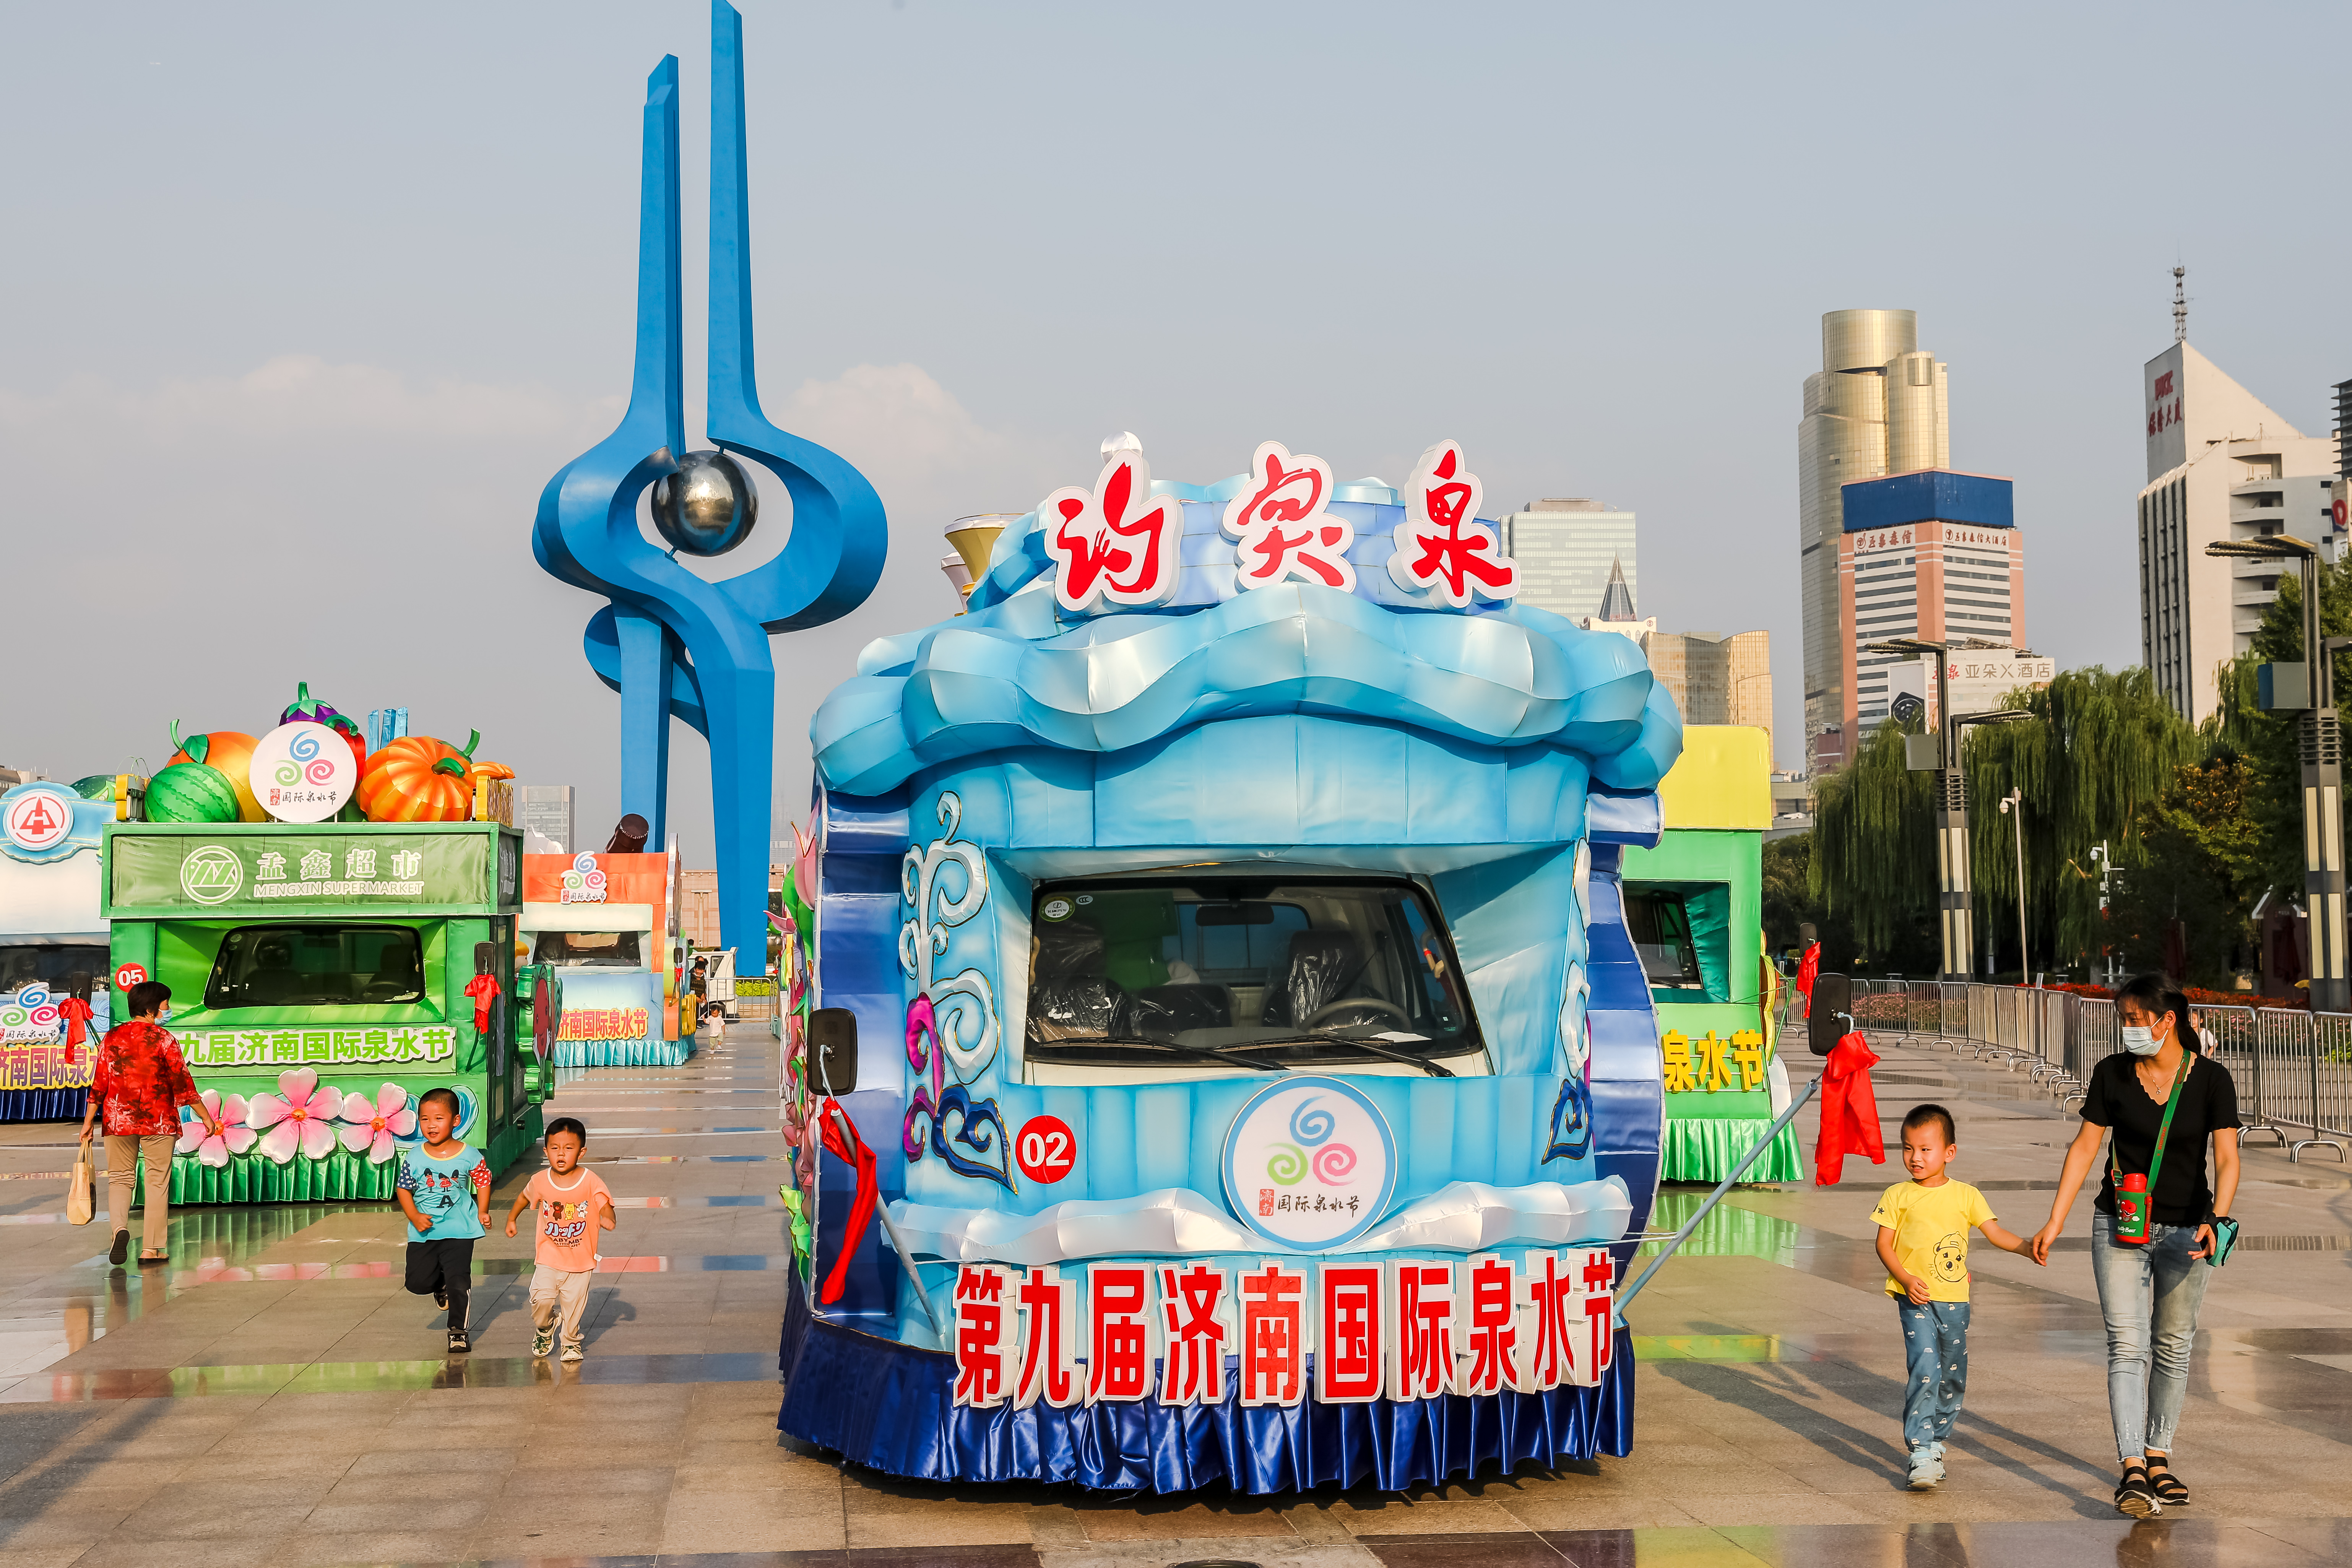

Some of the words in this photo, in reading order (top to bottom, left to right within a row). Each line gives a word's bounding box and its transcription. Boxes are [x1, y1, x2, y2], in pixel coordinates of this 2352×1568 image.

[2155, 370, 2173, 400] PICC
[283, 791, 337, 805] 国际泉水节
[257, 849, 422, 879] 孟鑫超市
[255, 881, 321, 897] MENGXIN
[324, 881, 424, 895] SUPERMARKET
[119, 969, 143, 986] 05
[179, 1029, 450, 1063] 九届济南国际泉水节
[1662, 1029, 1763, 1093] 泉水节
[1021, 1132, 1070, 1167] 02
[1278, 1194, 1359, 1218] 国际泉水节
[955, 1253, 1614, 1404] 第九届济南国际泉水节
